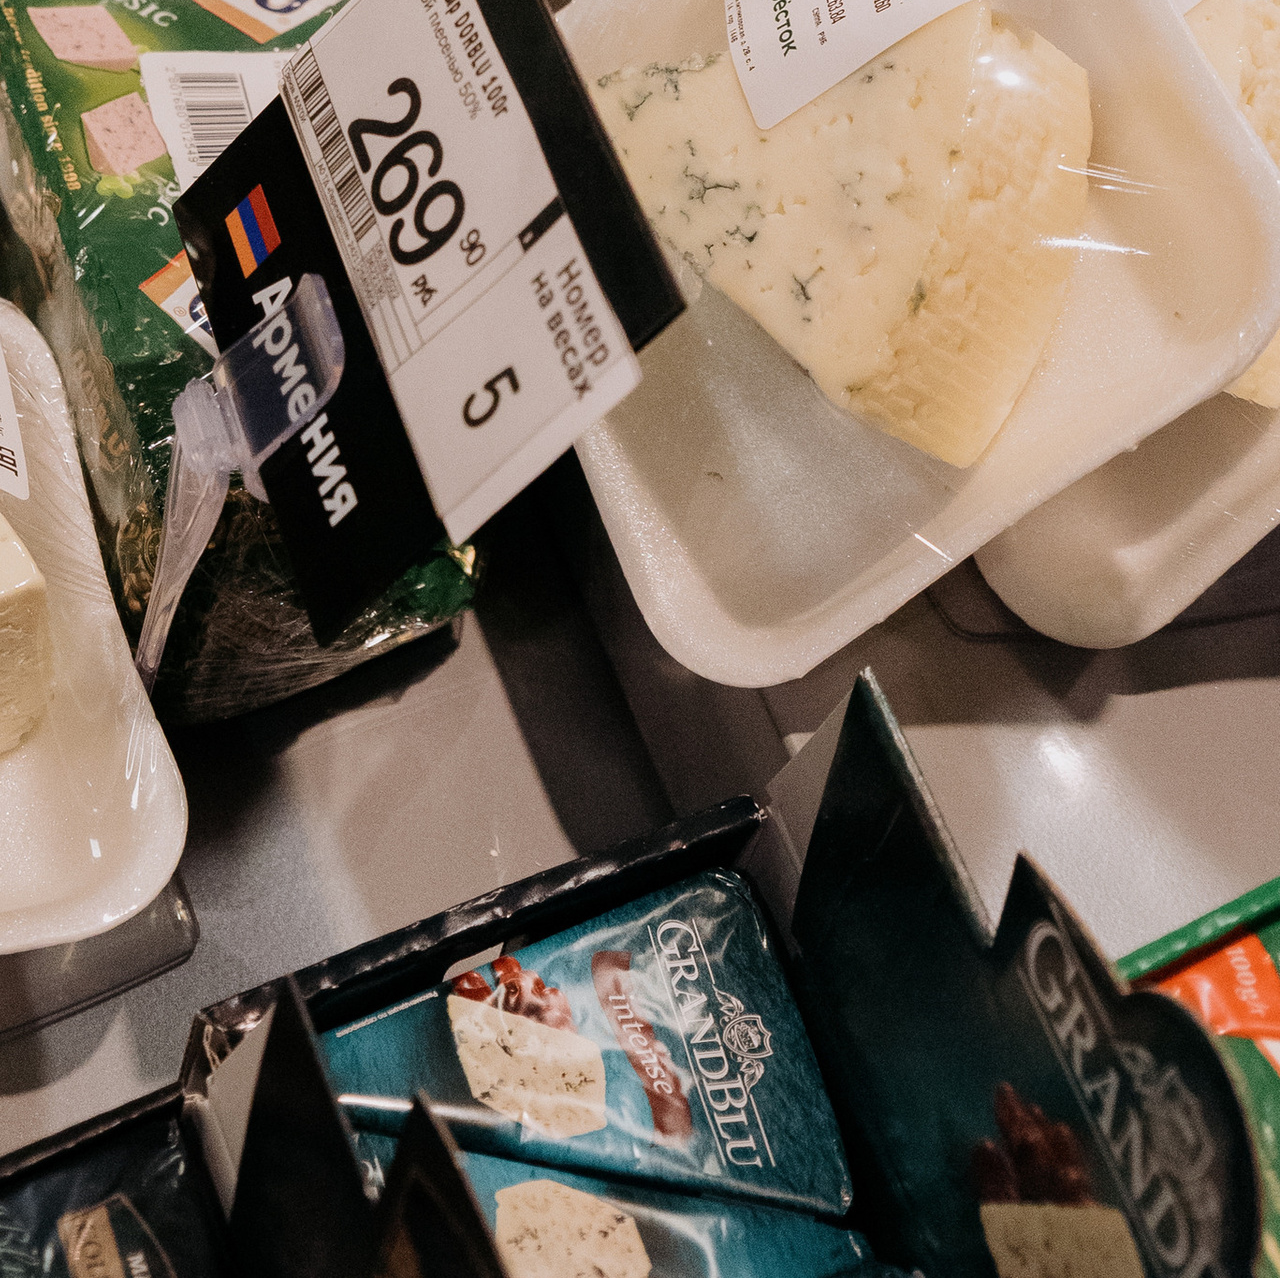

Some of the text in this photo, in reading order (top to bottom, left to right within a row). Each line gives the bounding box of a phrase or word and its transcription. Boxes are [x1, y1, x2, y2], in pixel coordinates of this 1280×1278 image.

[428, 11, 464, 84] плесенью
[458, 81, 482, 120] 50%
[454, 11, 492, 77] DORBLU
[481, 75, 508, 117] 100г
[818, 30, 828, 46] РУБ
[179, 119, 200, 164] 012549
[349, 76, 486, 267] 269 90
[531, 271, 592, 400] на весах
[537, 257, 610, 367] Номер
[250, 274, 360, 531] Армения
[462, 366, 520, 429] 5
[609, 993, 675, 1096] intense
[654, 920, 763, 1170] GRANDBLU
[1021, 920, 1202, 1267] GRAND
